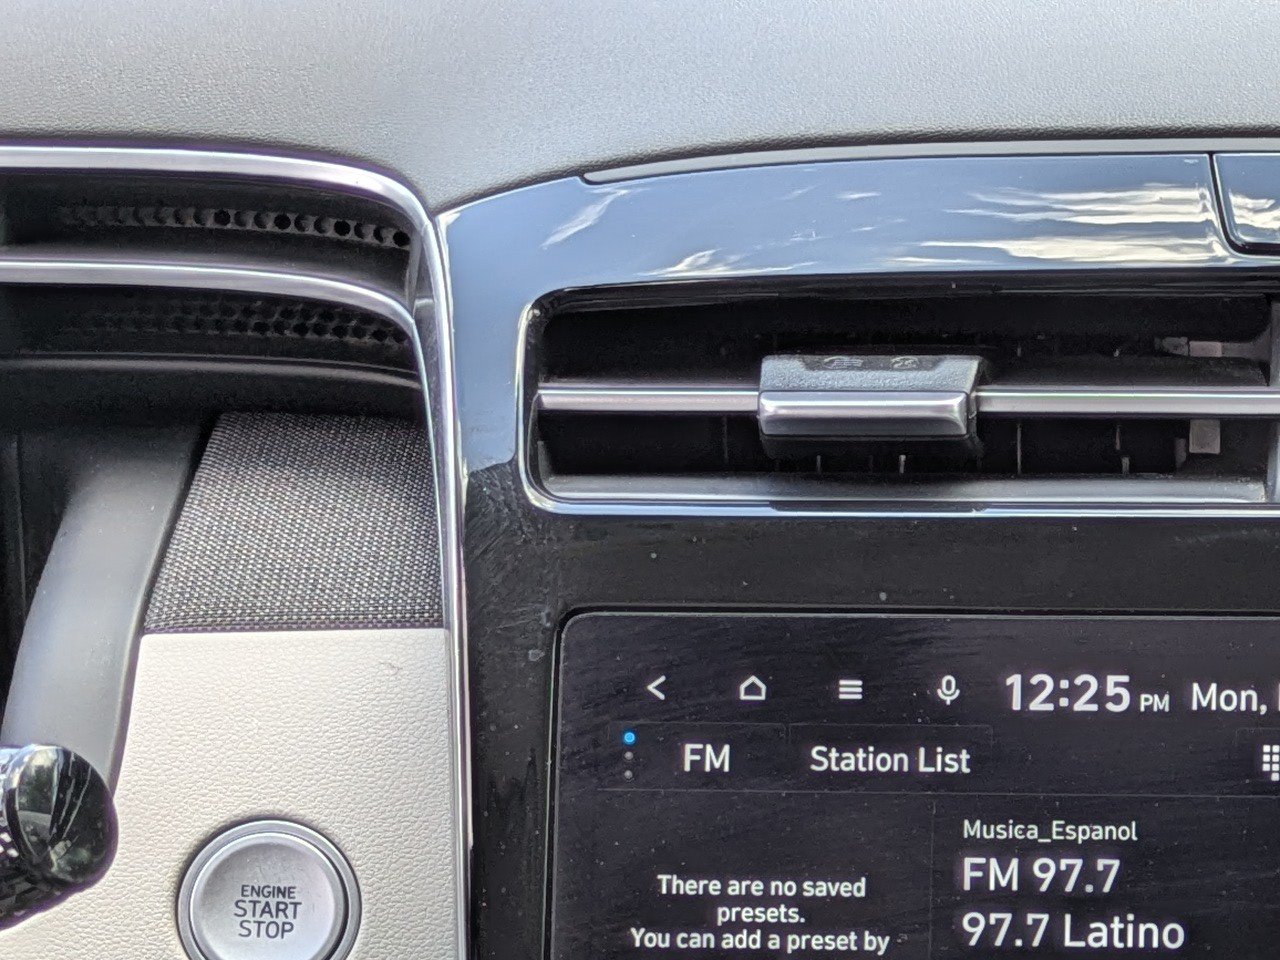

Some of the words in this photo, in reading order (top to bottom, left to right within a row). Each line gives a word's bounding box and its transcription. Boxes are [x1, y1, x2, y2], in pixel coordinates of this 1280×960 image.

[1005, 673, 1131, 713] 12:25
[1139, 693, 1170, 712] PM
[1191, 682, 1268, 715] Mon,
[683, 743, 730, 773] FM
[810, 745, 909, 773] Station
[918, 746, 971, 774] List
[963, 819, 1138, 845] Musica_Espanol
[656, 874, 722, 896] There
[727, 879, 765, 897] are
[770, 880, 797, 897] no
[802, 876, 867, 898] saved
[963, 856, 1019, 891] FM
[1032, 857, 1121, 893] 97.7
[241, 884, 297, 899] ENGINE
[234, 900, 302, 919] START
[717, 903, 806, 927] presets.
[238, 920, 294, 939] STOP
[630, 927, 671, 949] You
[677, 932, 715, 949] can
[721, 928, 762, 950] add
[767, 933, 781, 950] a
[786, 931, 858, 954] preset
[863, 930, 891, 956] by
[962, 911, 1050, 947] 97.7
[1064, 913, 1185, 950] Latino
